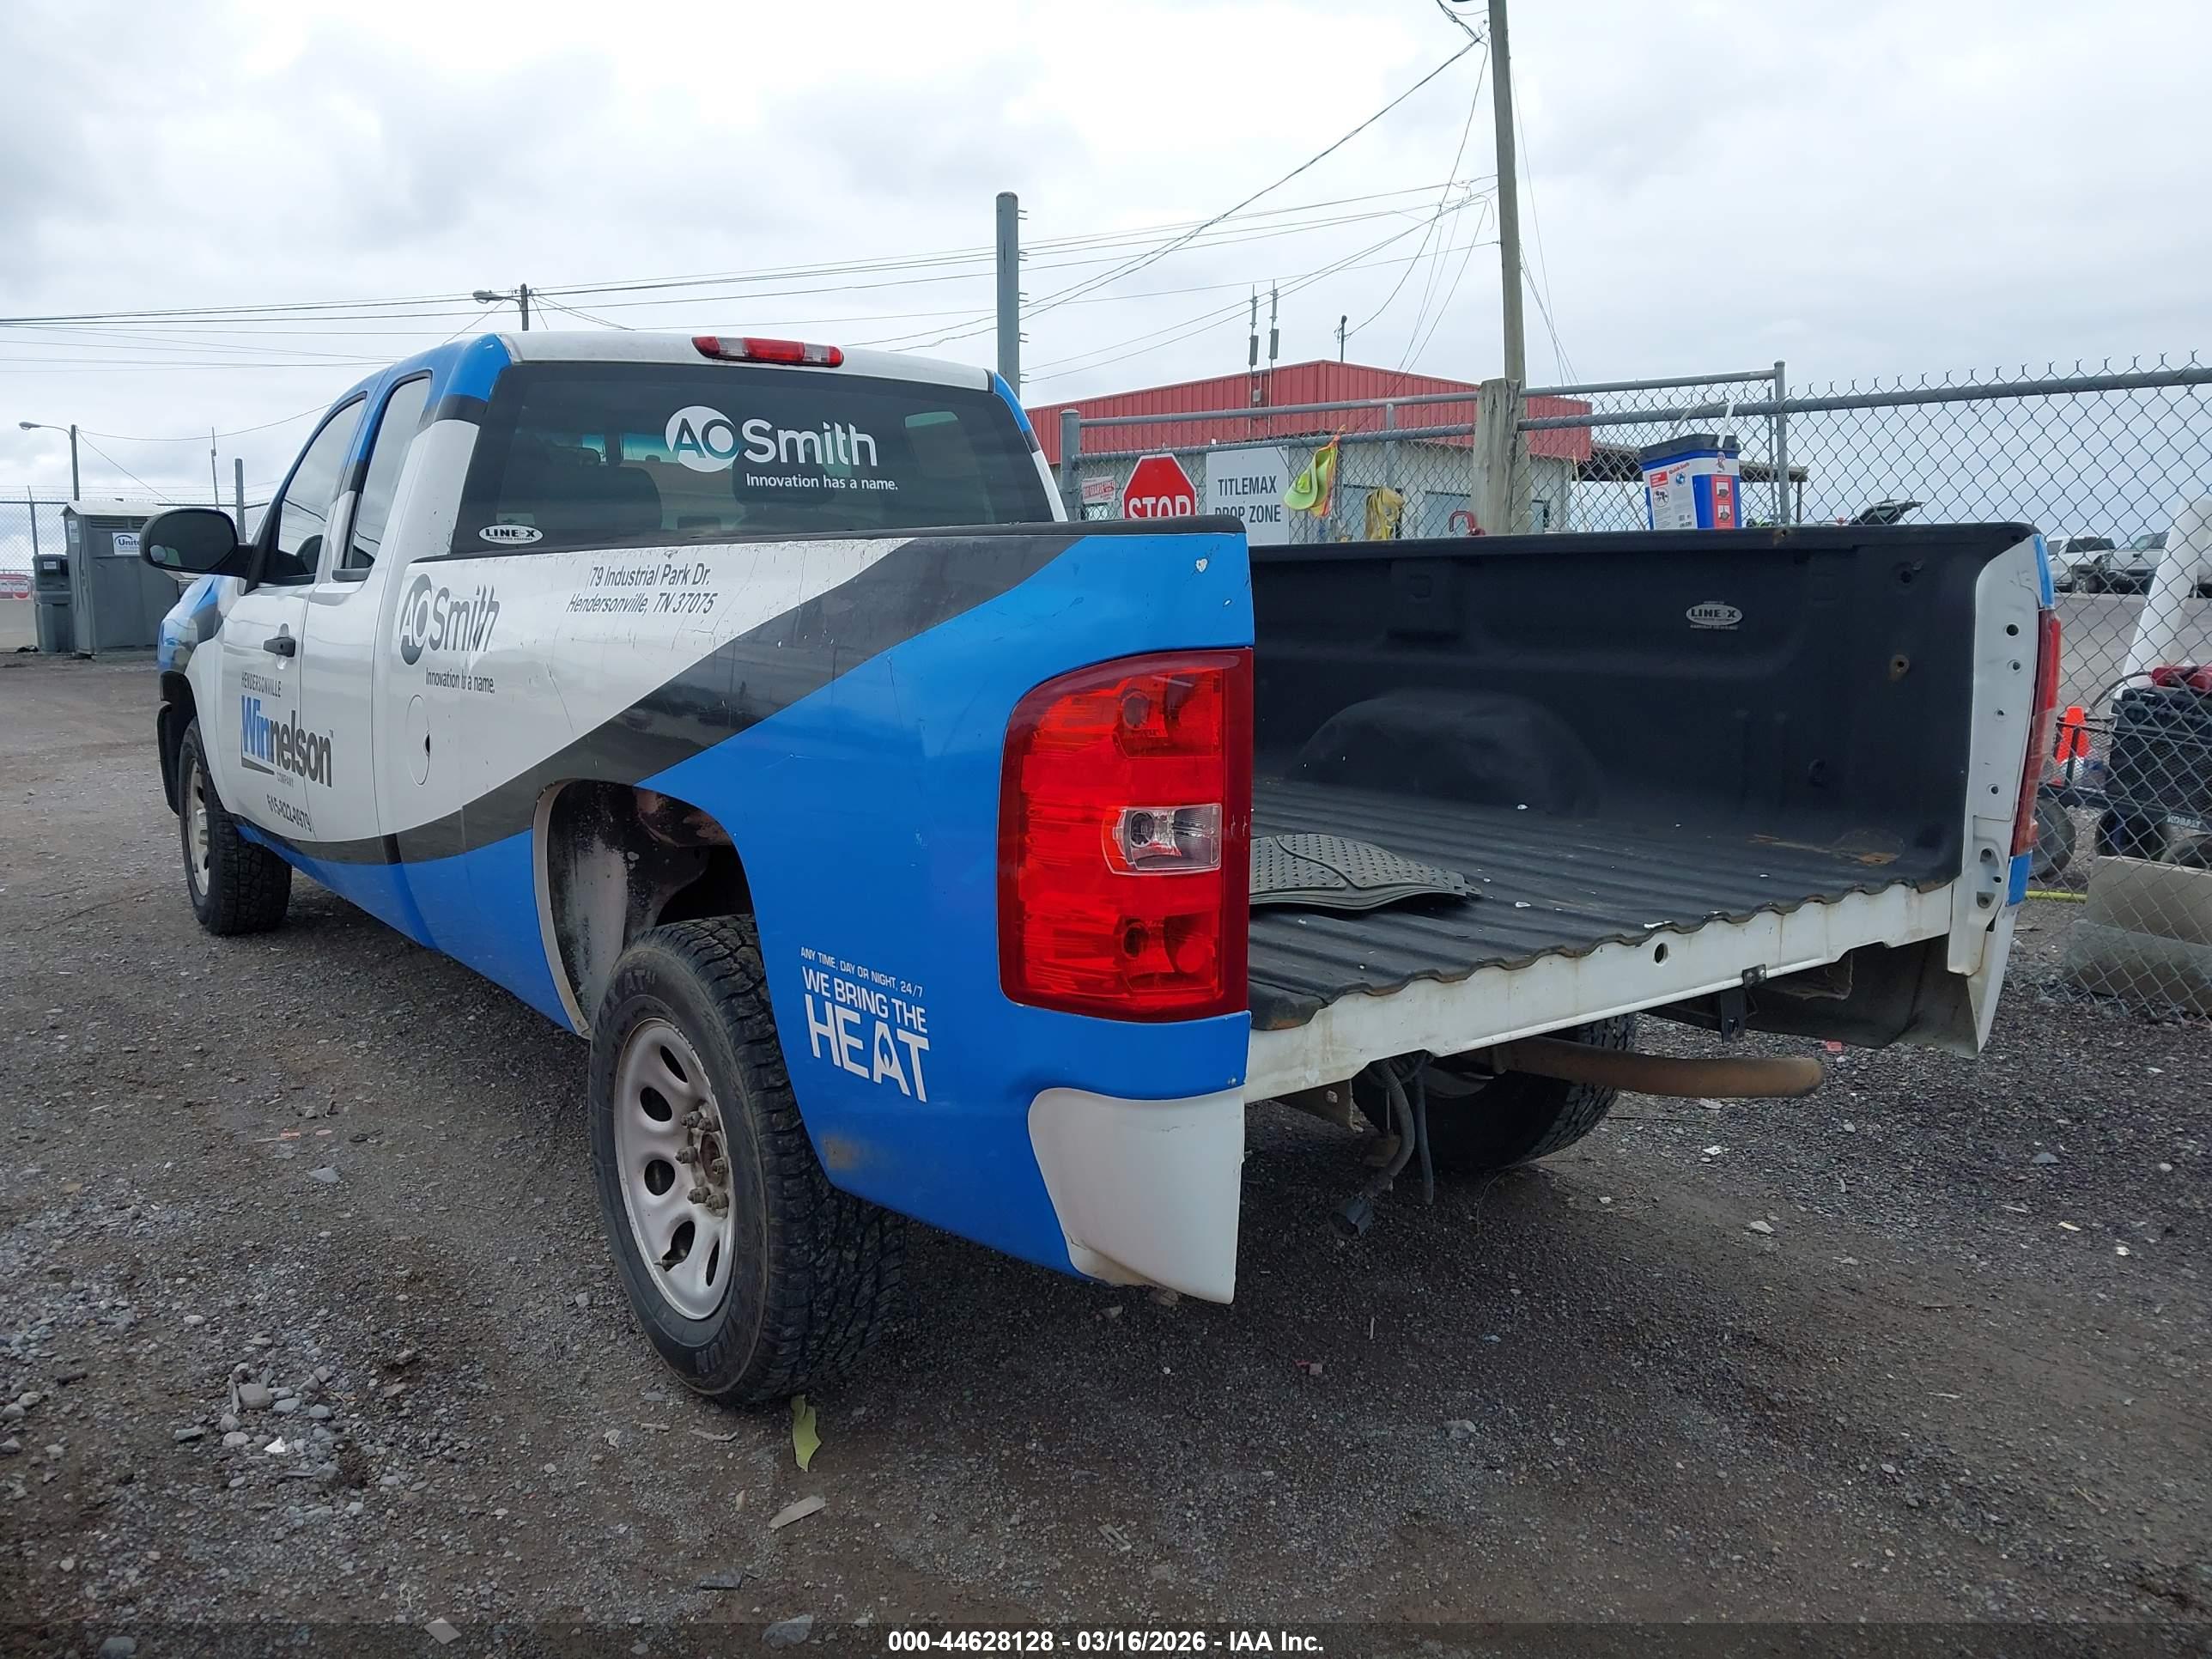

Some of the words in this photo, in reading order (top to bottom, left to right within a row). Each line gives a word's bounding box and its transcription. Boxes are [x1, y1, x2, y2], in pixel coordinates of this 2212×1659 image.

[740, 418, 878, 466] Smith
[746, 472, 819, 488] Innovation
[823, 474, 845, 489] has
[849, 478, 857, 489] a
[861, 478, 898, 490] name.
[1218, 475, 1278, 496] TITLEMAX
[1249, 504, 1281, 523] ZONE
[118, 538, 139, 546] Unit
[485, 528, 536, 538] LINE-X
[590, 567, 604, 587] 79
[604, 563, 660, 587] Industrial
[659, 562, 691, 586] Park
[691, 562, 711, 586] Dr.
[565, 592, 648, 617] Hendersonville,
[653, 592, 677, 613] TN
[672, 592, 719, 614] 37075
[428, 584, 501, 653] Smith
[241, 672, 282, 698] HENDERSONVILLE
[425, 666, 460, 689] Innovation
[474, 676, 495, 694] name.
[241, 695, 333, 788] Winnelson
[2166, 815, 2201, 828] KOBALT
[800, 946, 816, 961] ANY
[817, 951, 838, 970] TIME,
[840, 960, 855, 975] DAY
[857, 965, 869, 980] OR
[871, 970, 898, 991] NIGHT,
[901, 981, 923, 998] 24/7
[802, 965, 831, 998] WE
[833, 977, 889, 1018] BRING
[890, 998, 927, 1034] THE
[805, 994, 930, 1103] HEAT
